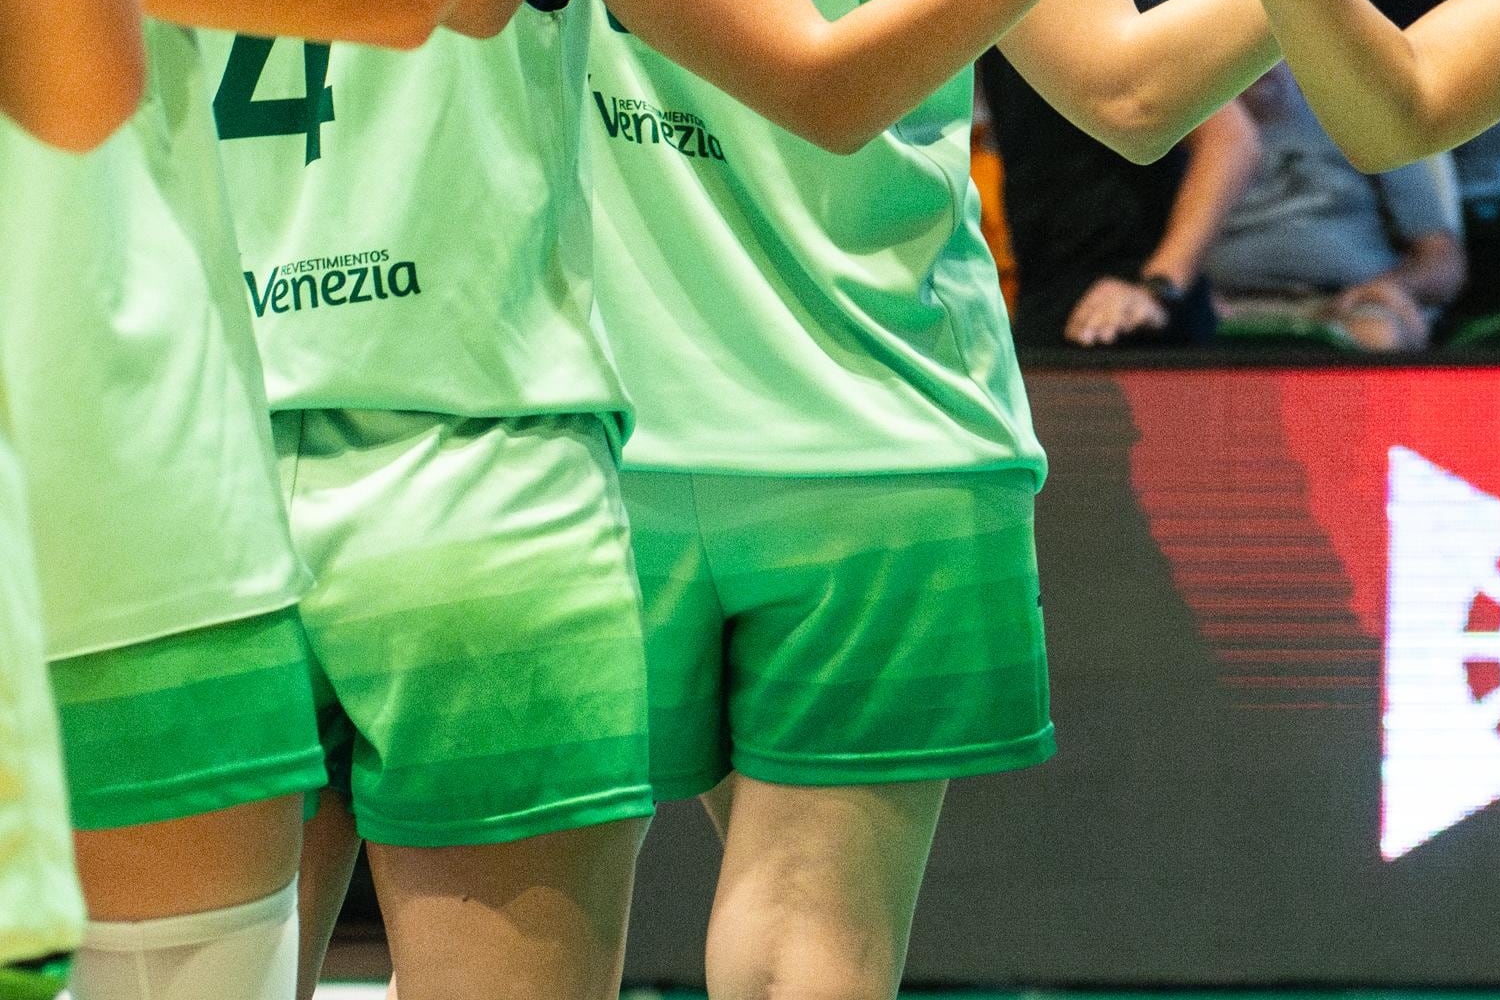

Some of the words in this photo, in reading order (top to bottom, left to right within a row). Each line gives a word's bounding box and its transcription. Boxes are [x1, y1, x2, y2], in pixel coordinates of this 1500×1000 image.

[593, 91, 728, 164] Venezia
[243, 261, 421, 318] Venezia
[281, 249, 389, 275] REVESTIMIENTOS
